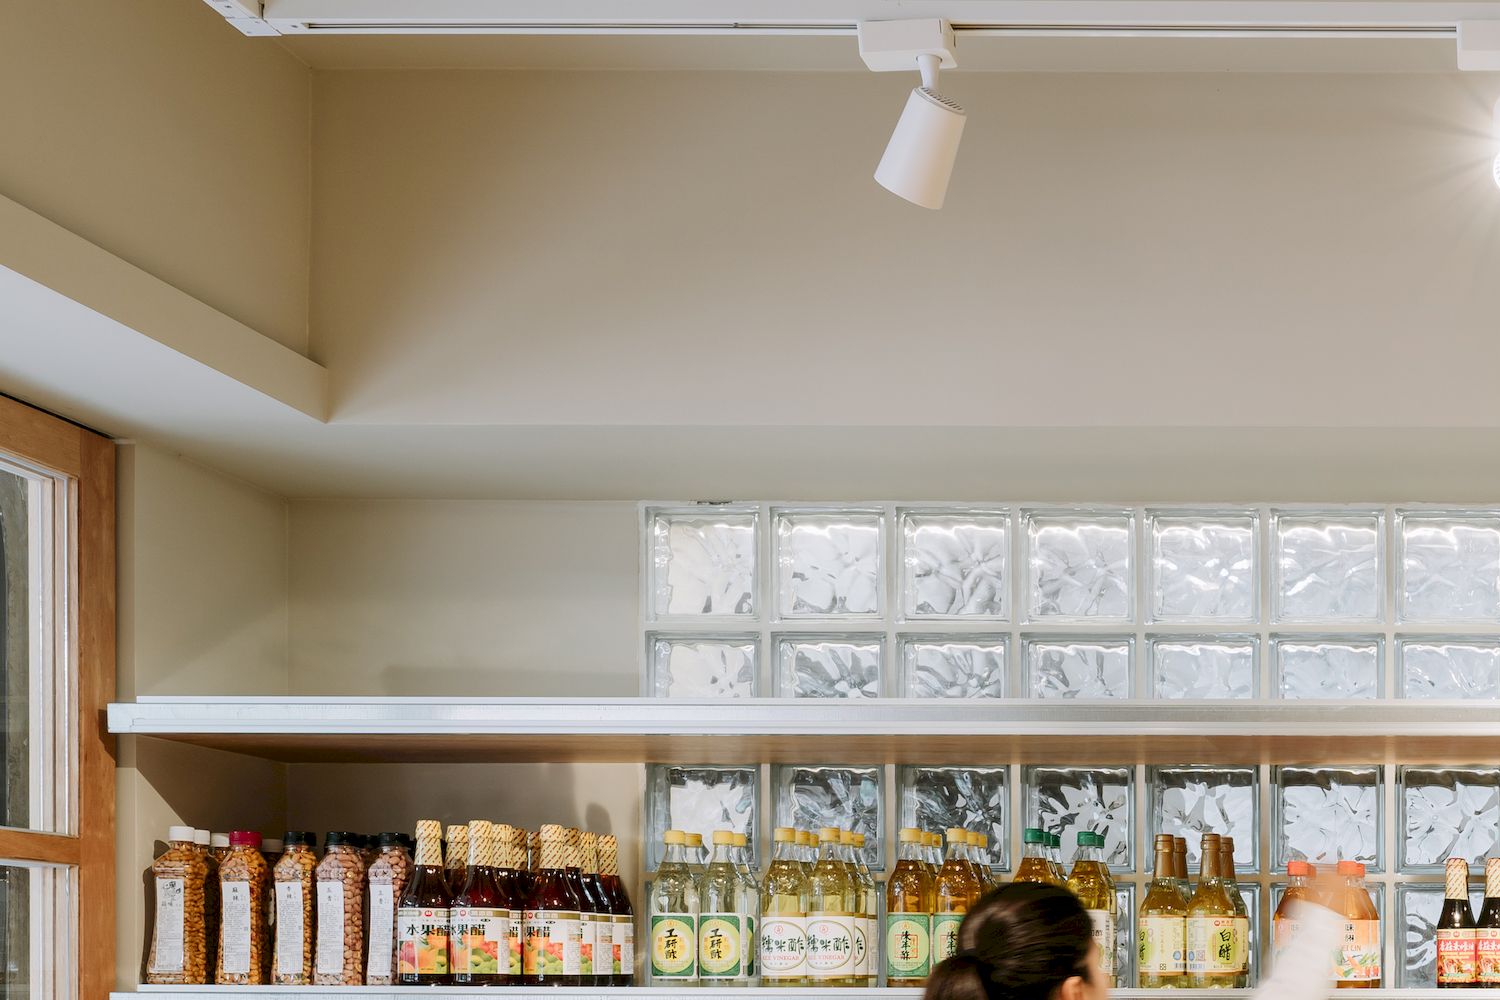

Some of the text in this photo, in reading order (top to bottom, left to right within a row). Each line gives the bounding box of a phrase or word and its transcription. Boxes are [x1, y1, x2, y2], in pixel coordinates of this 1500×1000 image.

[664, 928, 678, 960] 工研酢
[709, 928, 723, 960] 工研酢
[1218, 928, 1231, 960] 白醋
